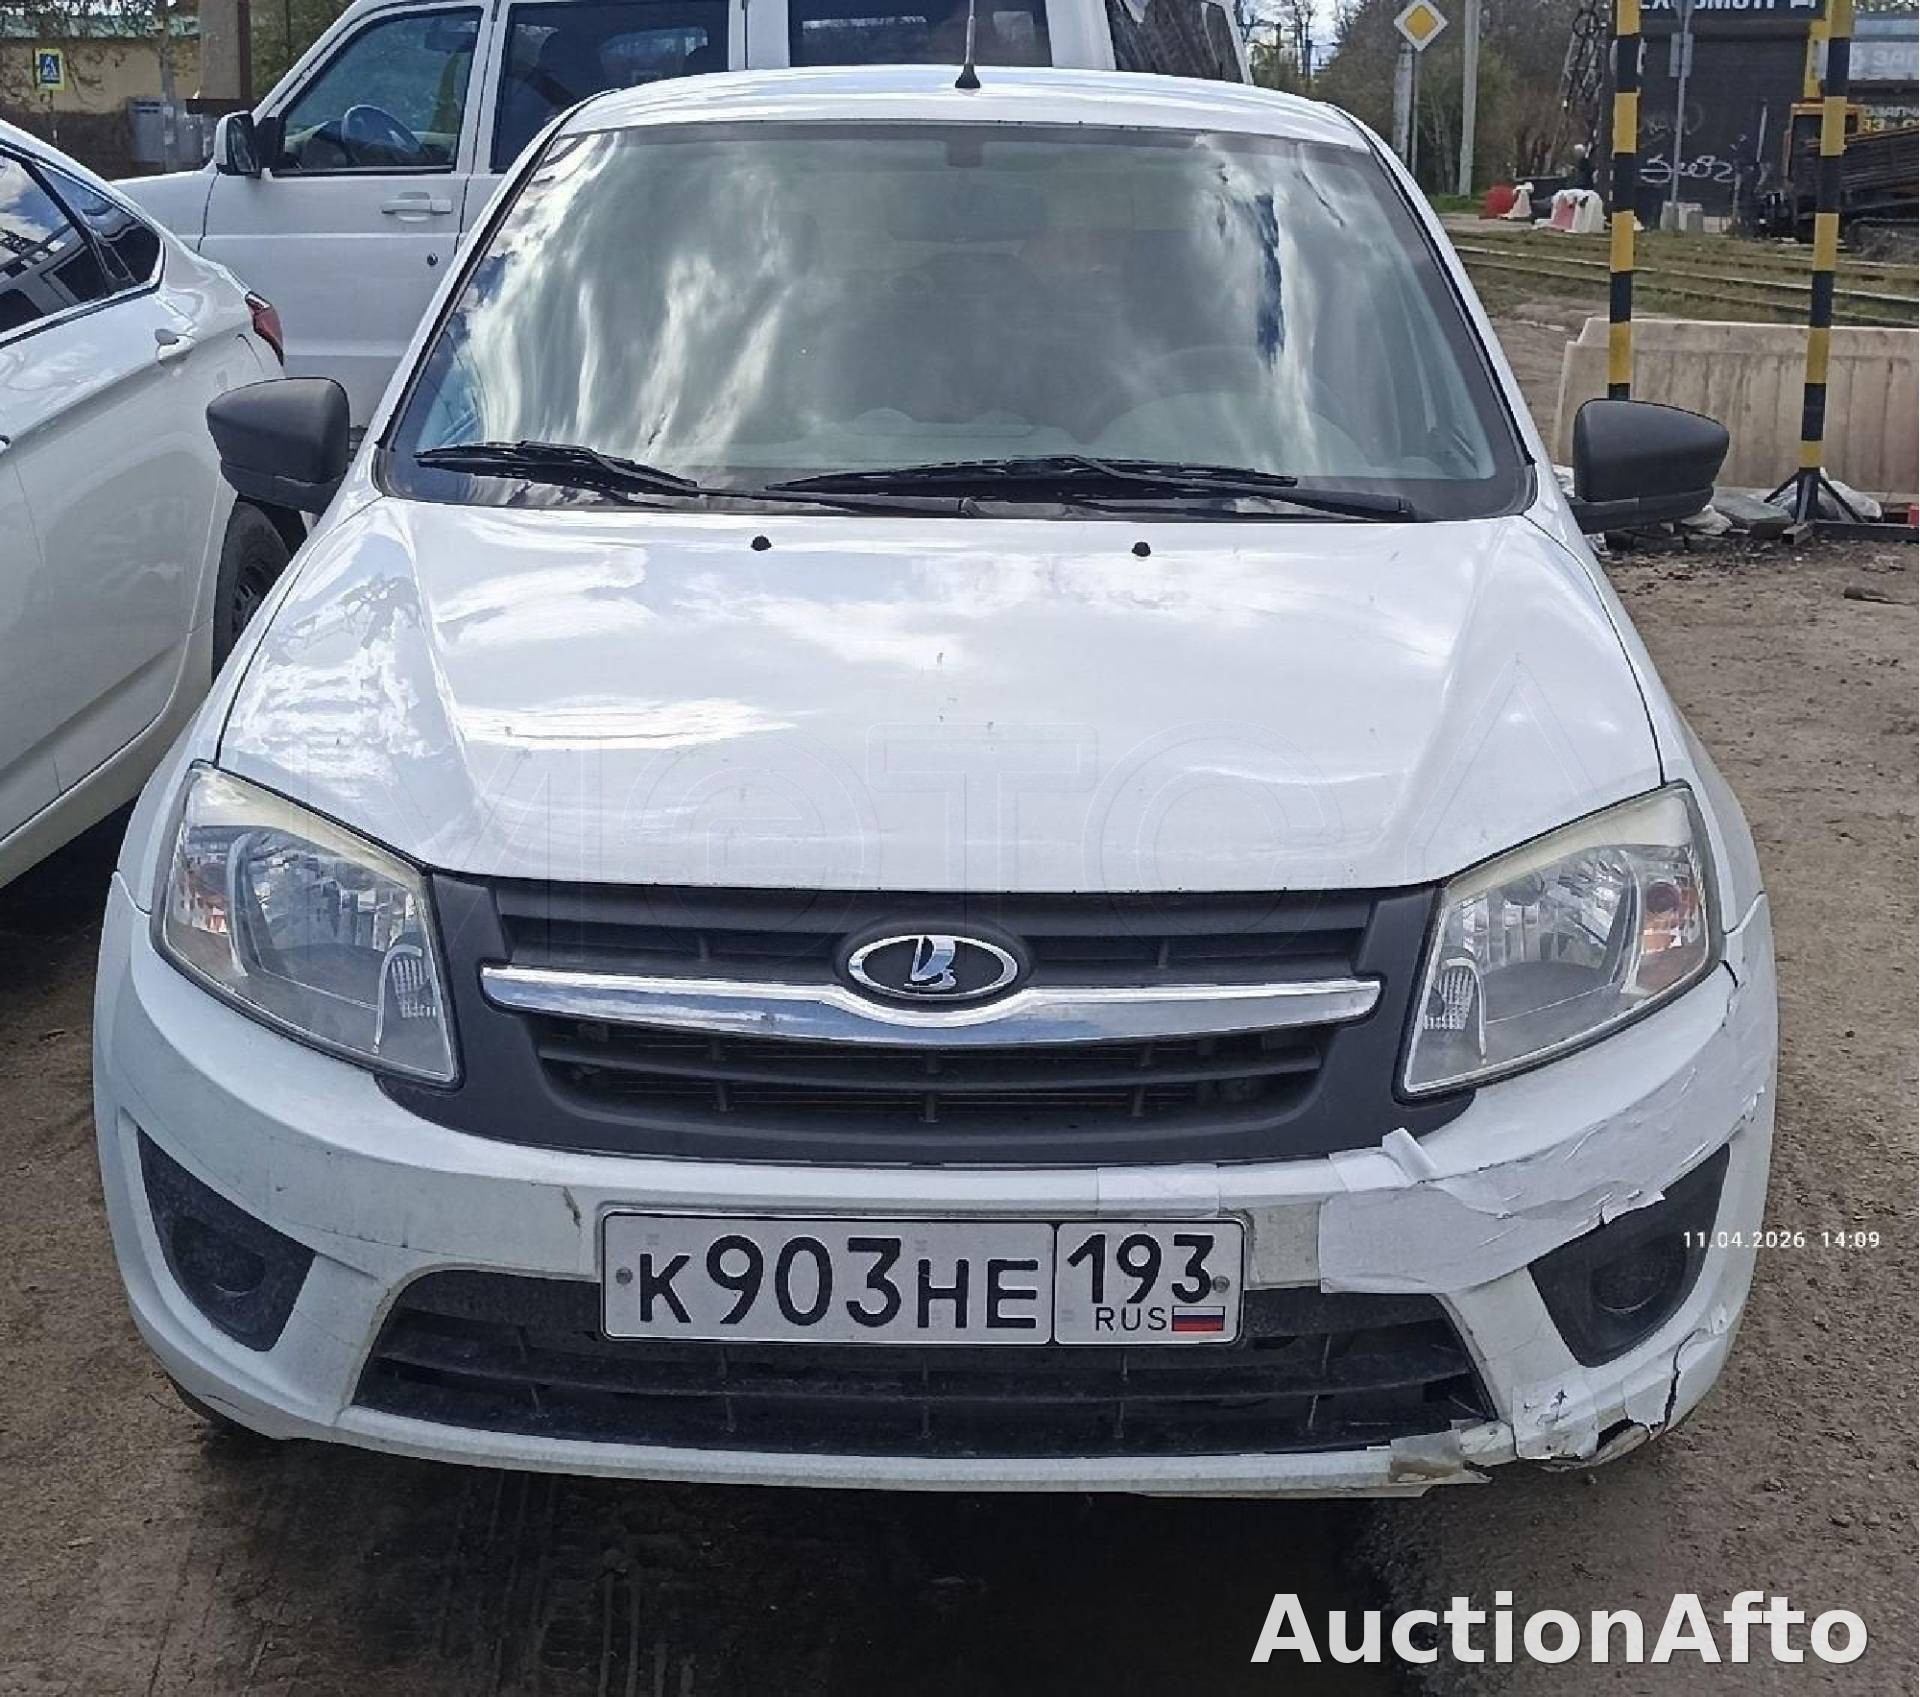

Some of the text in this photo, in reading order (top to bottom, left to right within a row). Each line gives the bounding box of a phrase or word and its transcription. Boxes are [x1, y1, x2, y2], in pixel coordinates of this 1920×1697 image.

[639, 1233, 1215, 1329] К903НЕ 193
[1095, 1306, 1167, 1331] RUS
